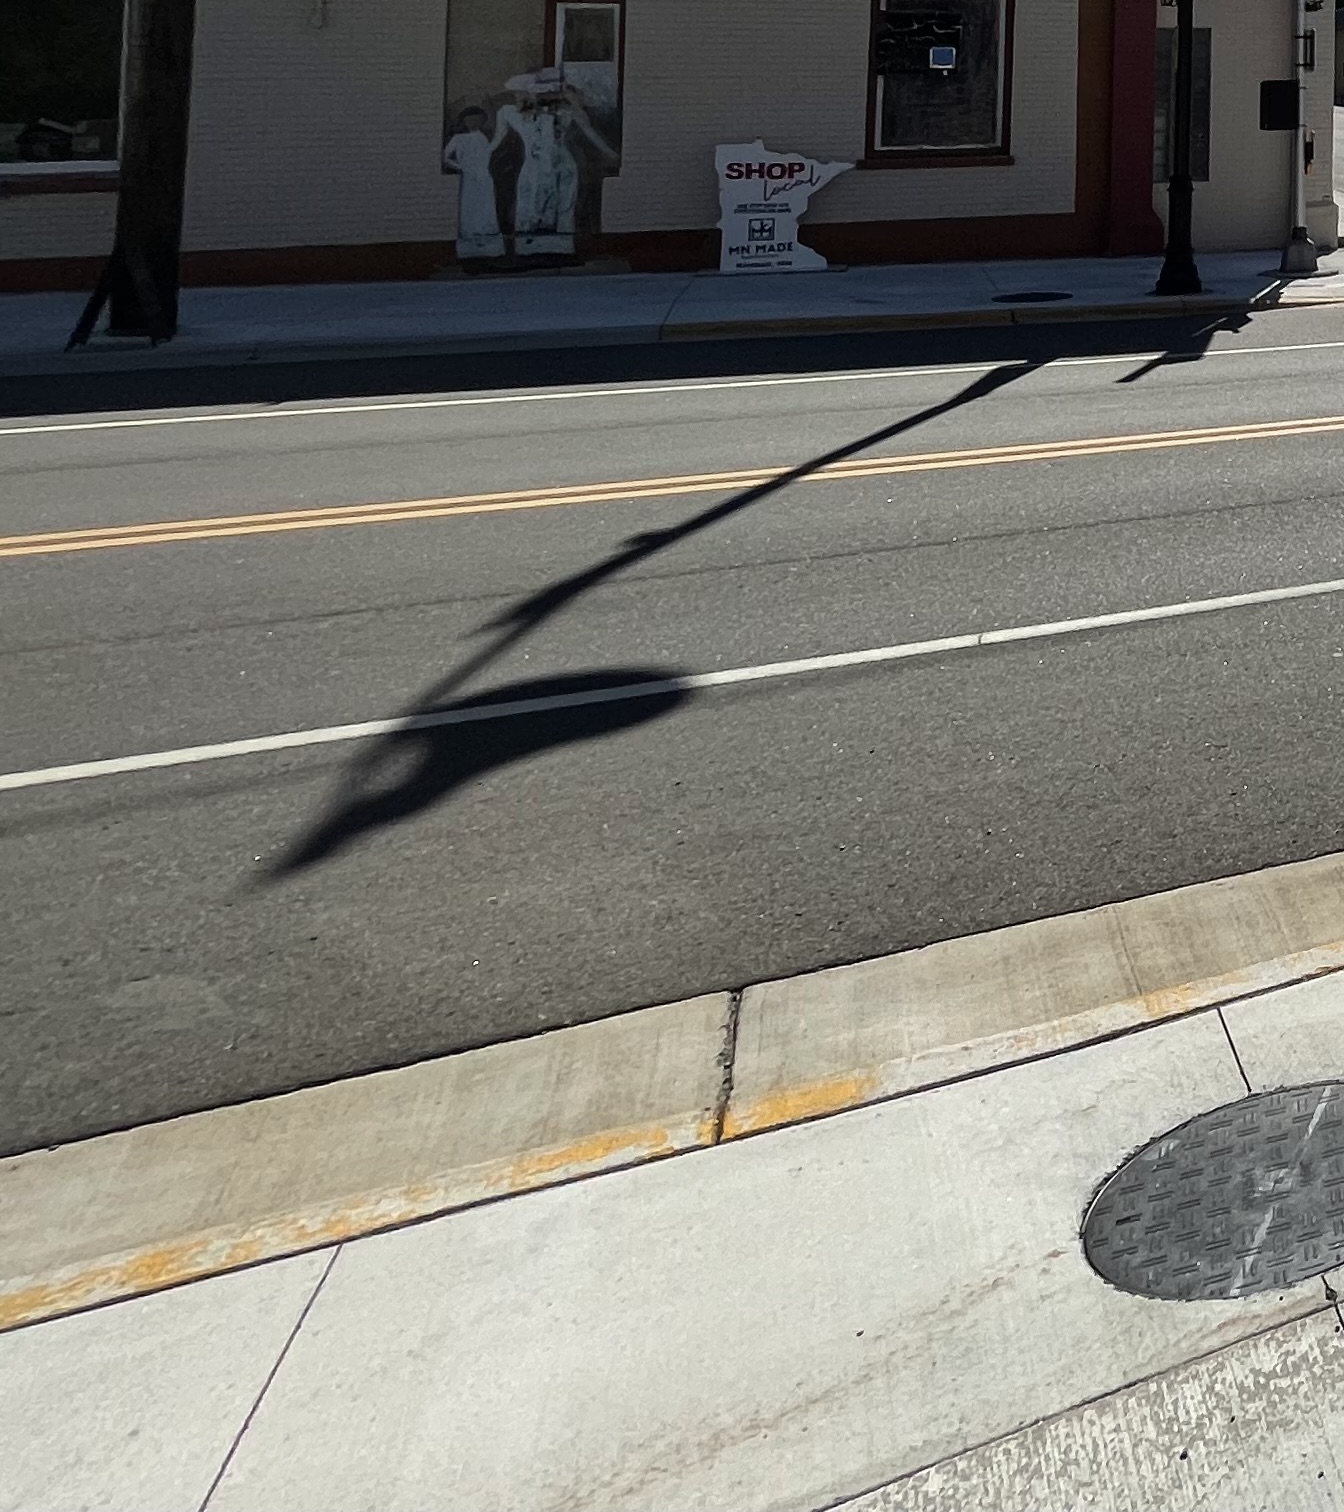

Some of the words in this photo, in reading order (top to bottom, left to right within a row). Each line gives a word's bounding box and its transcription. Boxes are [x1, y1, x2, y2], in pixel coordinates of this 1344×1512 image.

[725, 162, 805, 180] SHOP
[764, 164, 821, 201] local
[728, 245, 751, 256] MN
[756, 241, 793, 254] MADE
